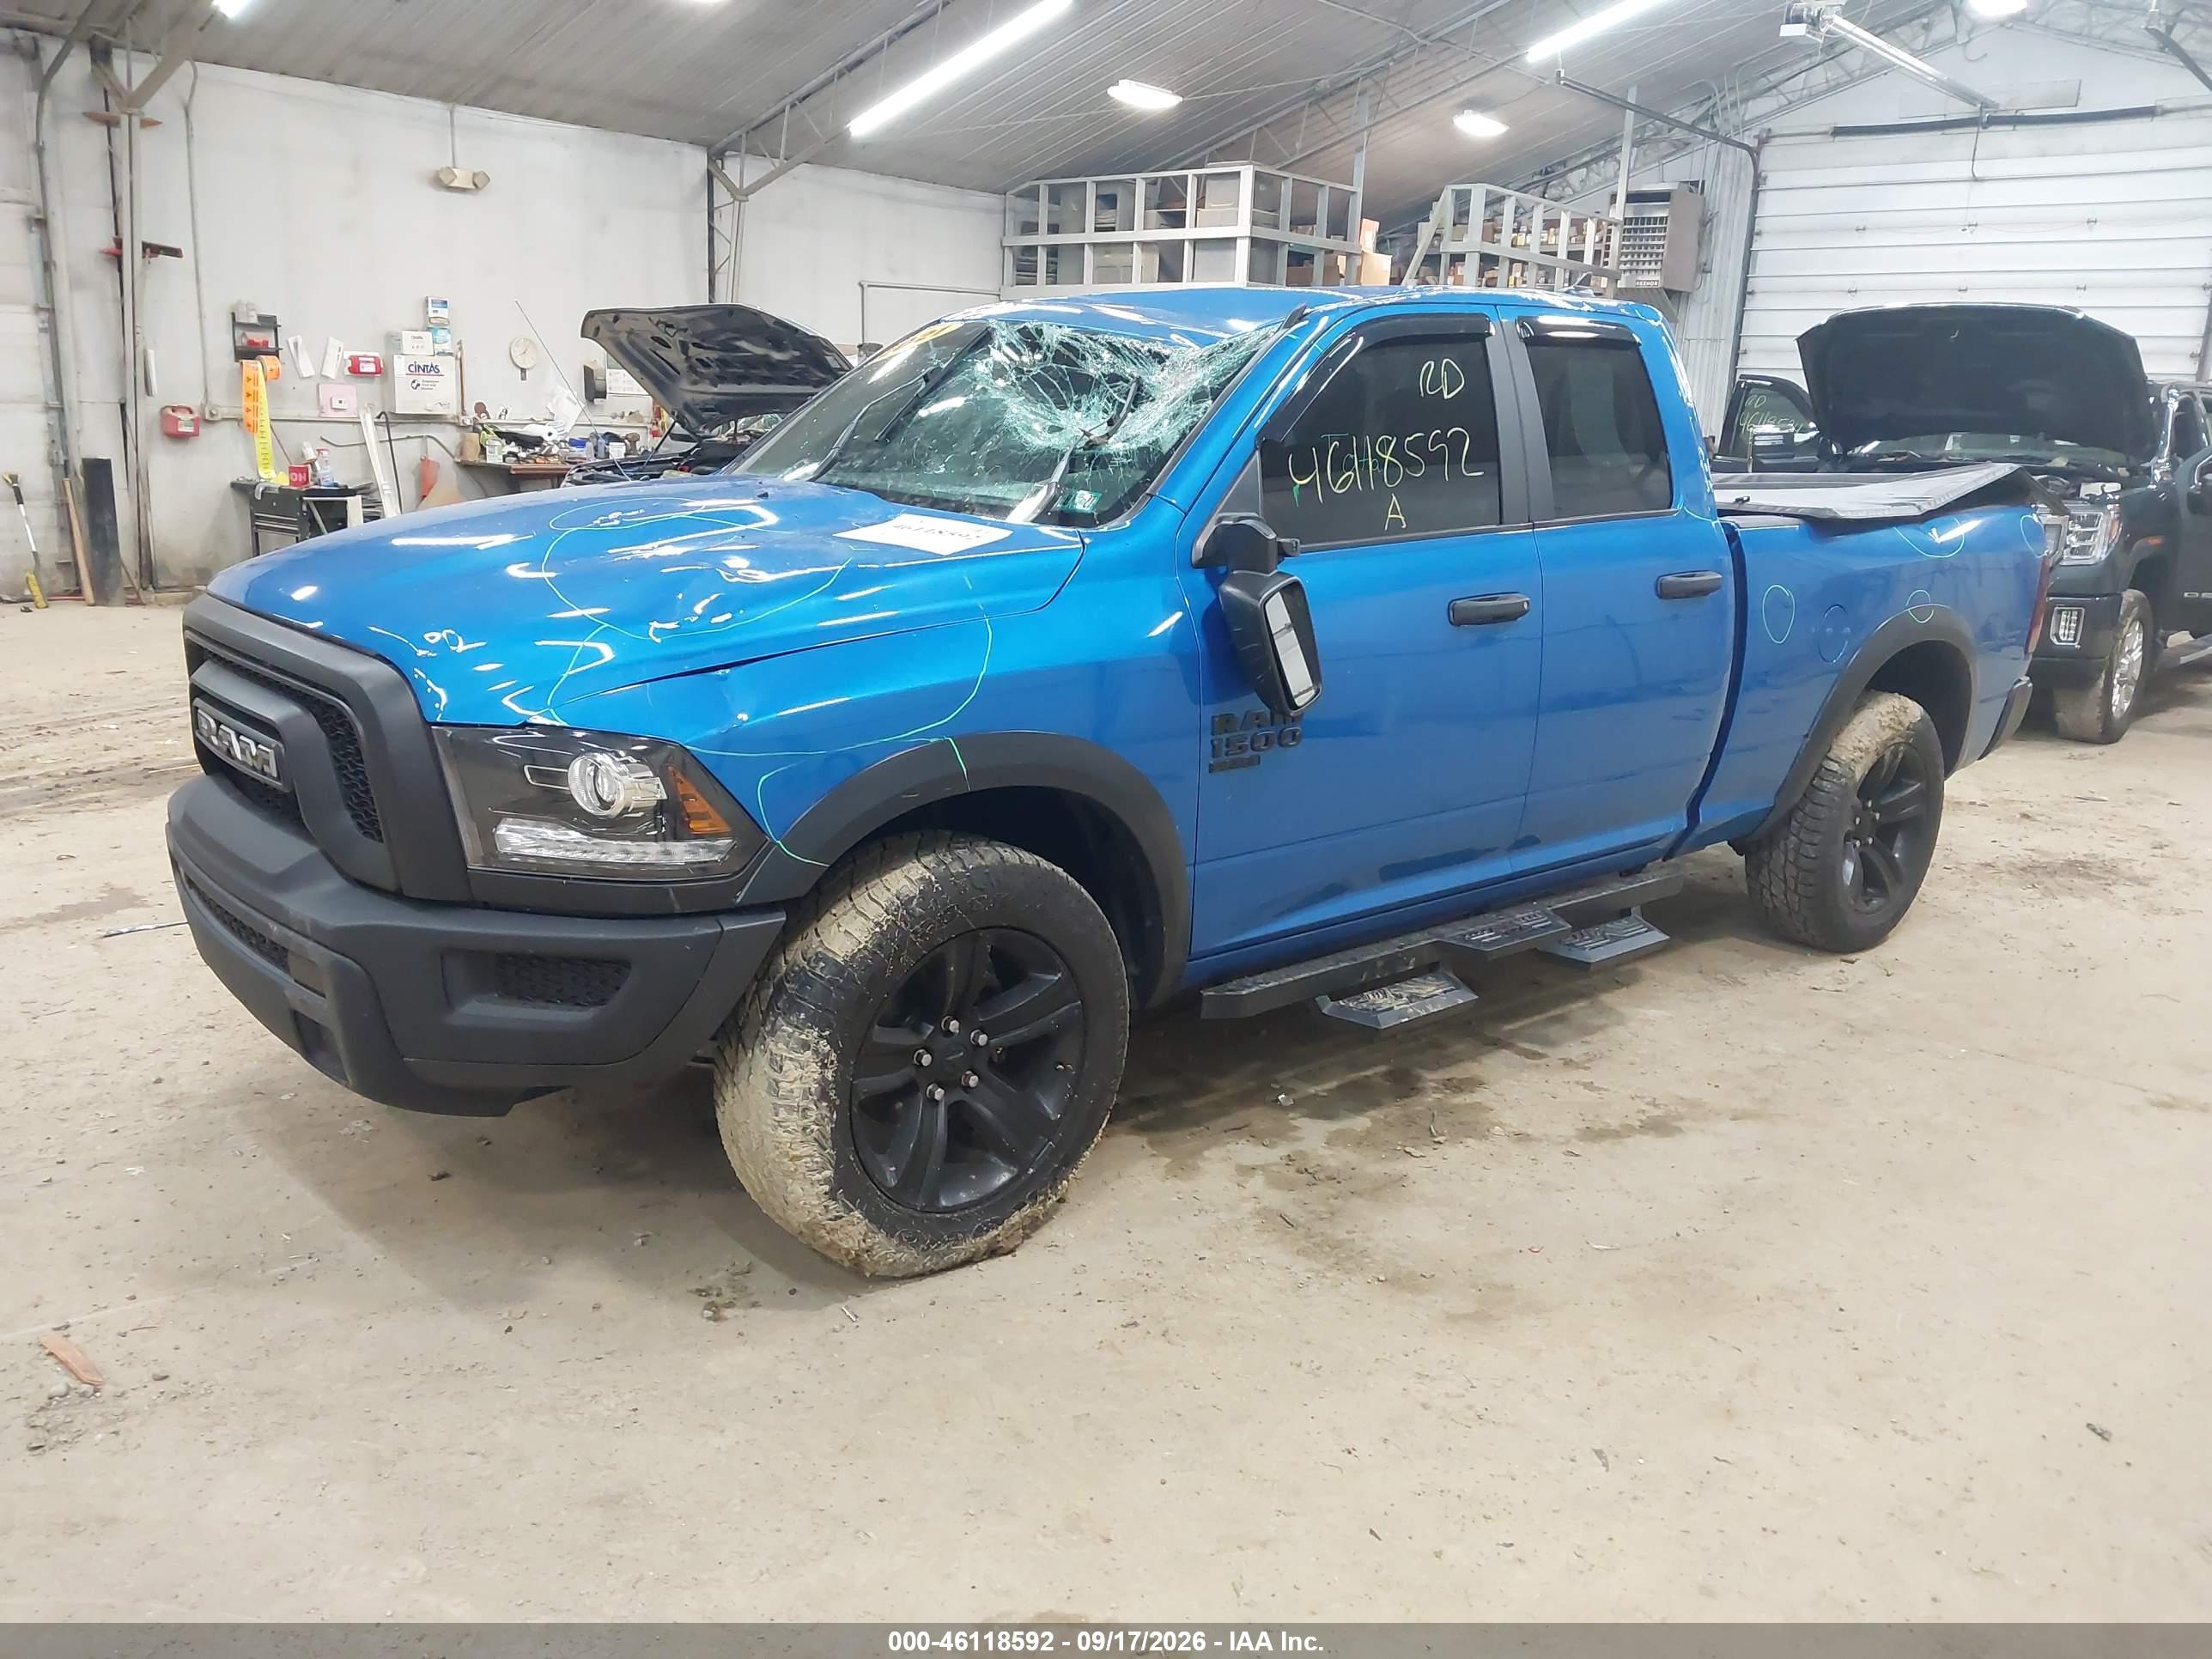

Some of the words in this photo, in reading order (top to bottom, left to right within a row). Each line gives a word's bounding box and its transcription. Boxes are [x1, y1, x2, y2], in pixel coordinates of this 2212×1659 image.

[1384, 493, 1407, 531] A
[197, 708, 277, 777] RAM
[1211, 727, 1302, 758] 1500
